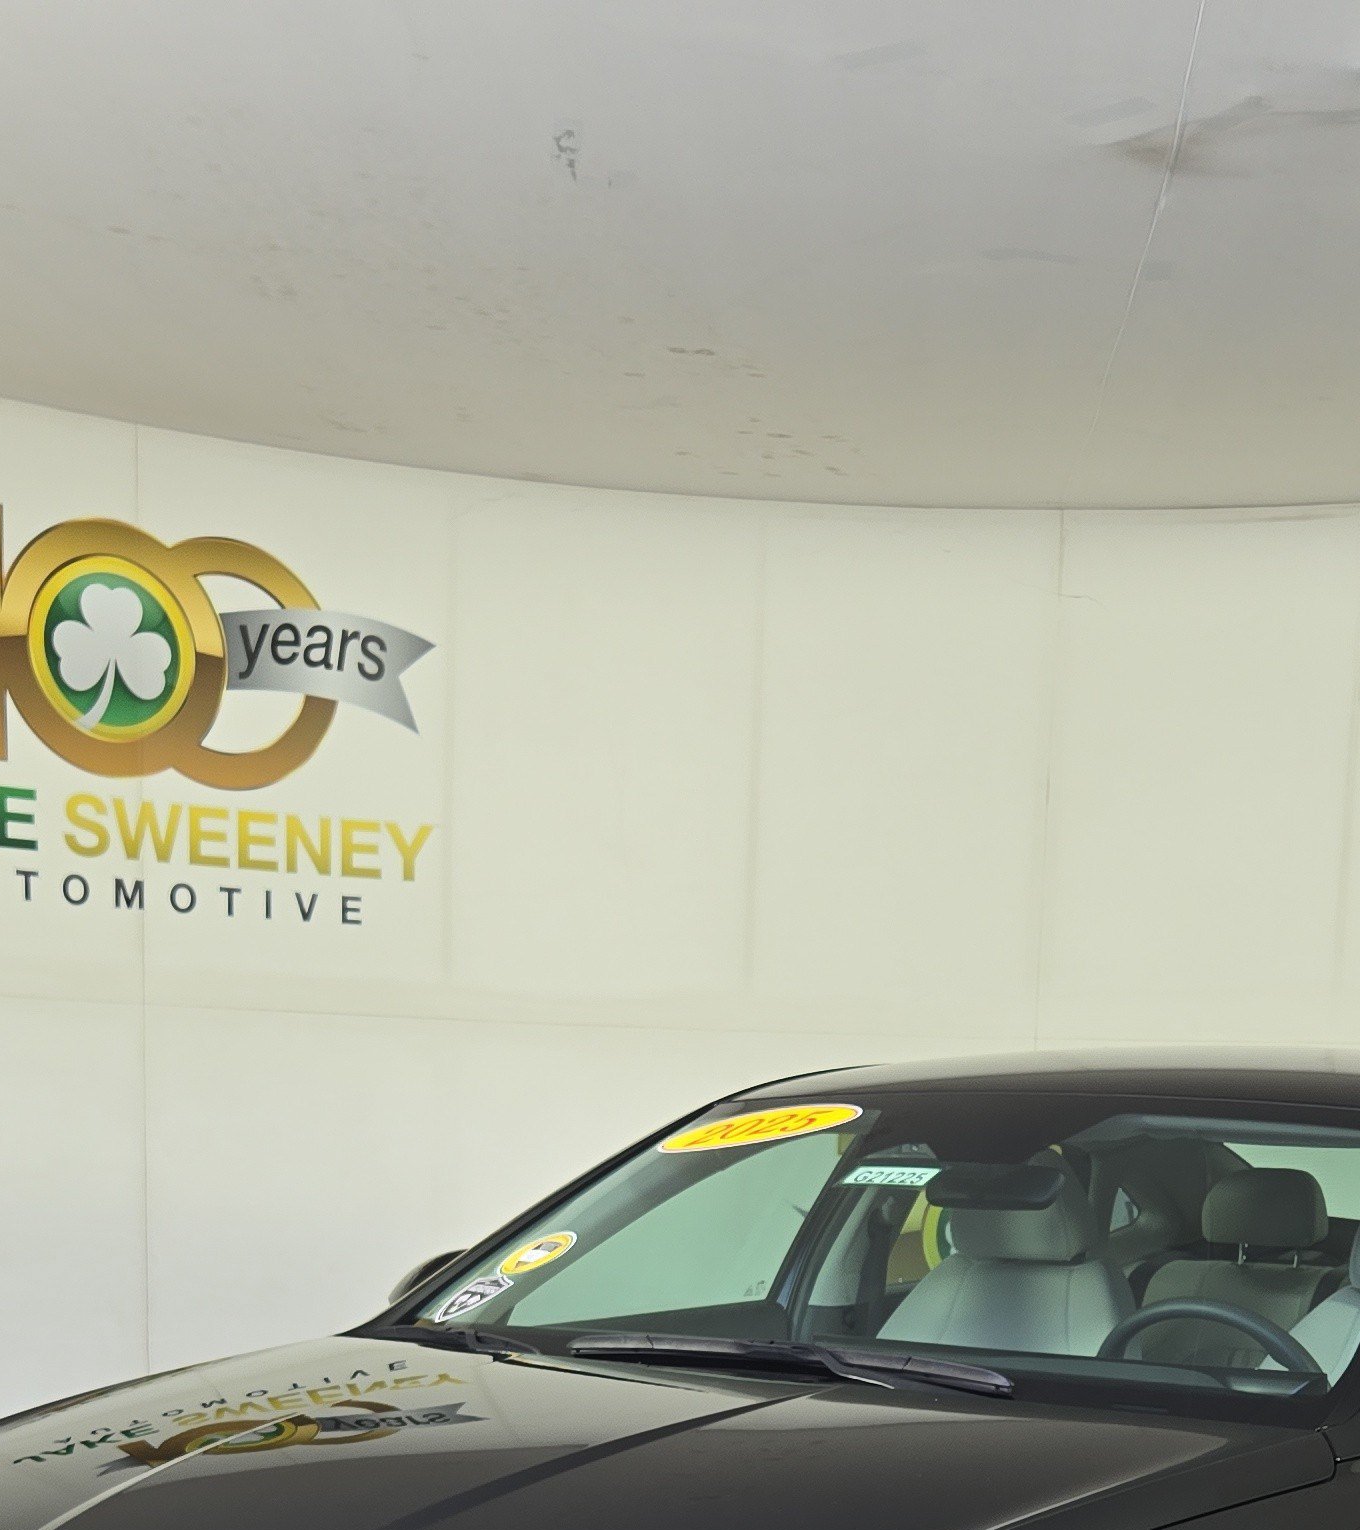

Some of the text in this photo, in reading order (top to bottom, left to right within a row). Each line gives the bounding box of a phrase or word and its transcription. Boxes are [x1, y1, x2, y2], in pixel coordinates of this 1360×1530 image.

[238, 616, 388, 682] years
[63, 792, 433, 882] SWEENEY
[684, 1109, 835, 1147] 2025
[853, 1170, 928, 1185] G21225
